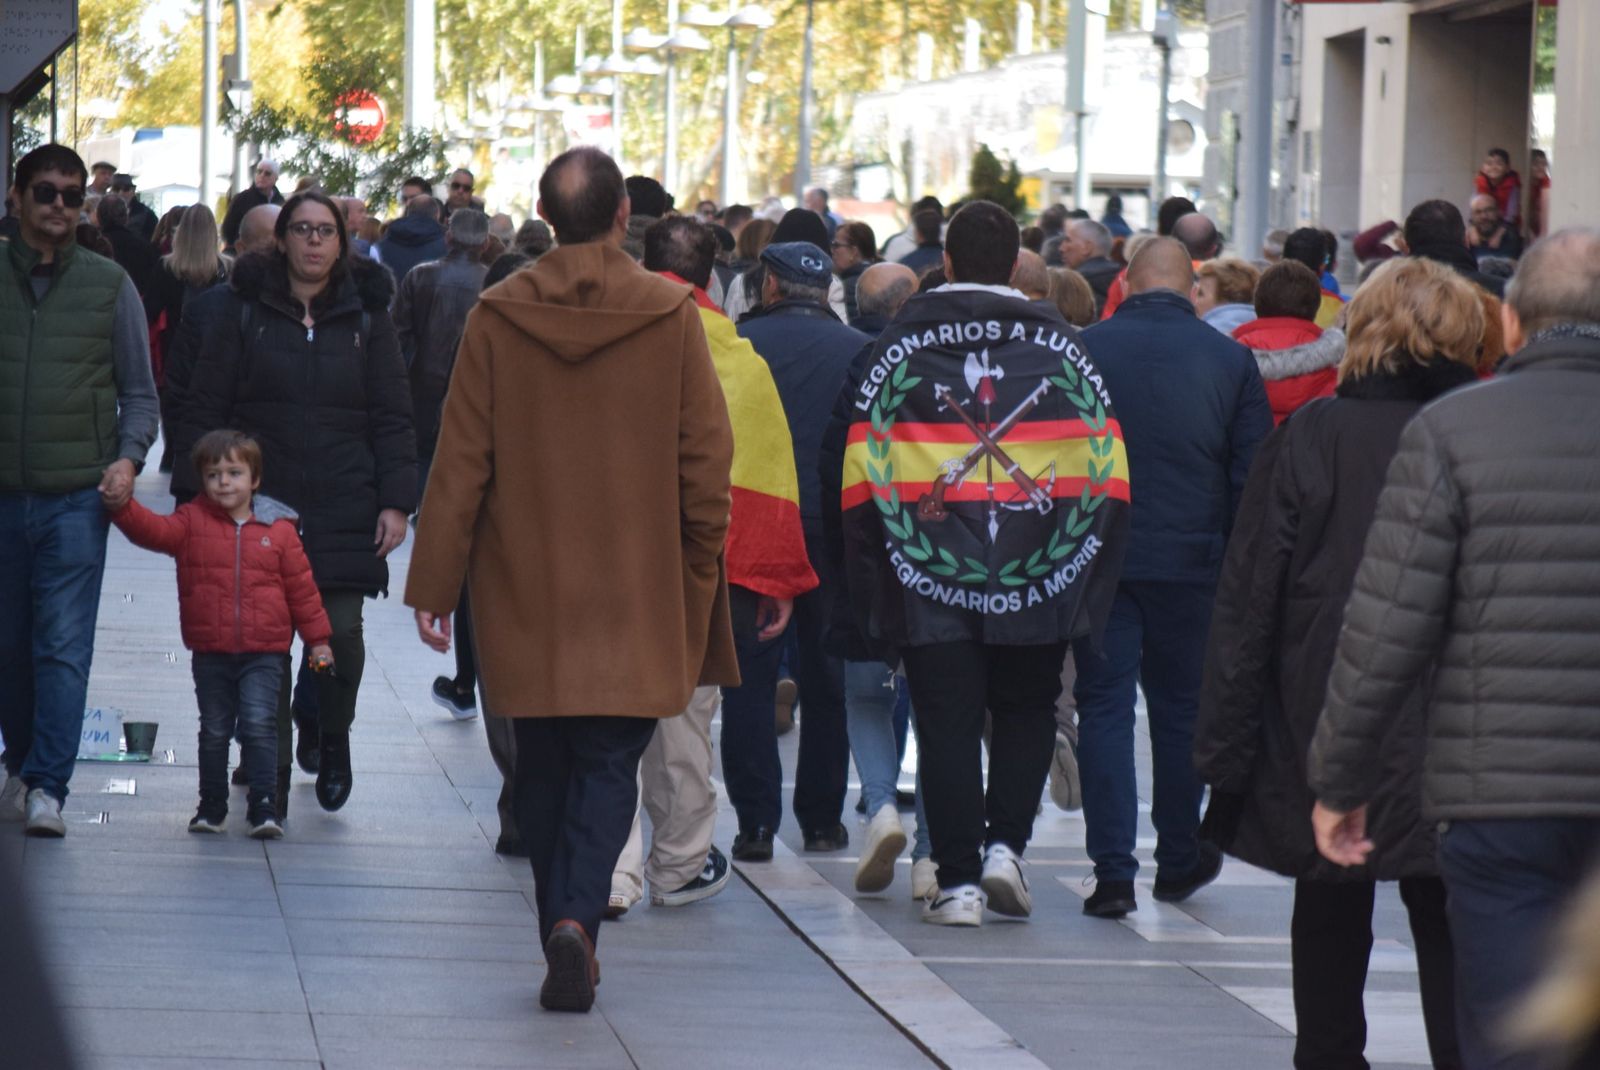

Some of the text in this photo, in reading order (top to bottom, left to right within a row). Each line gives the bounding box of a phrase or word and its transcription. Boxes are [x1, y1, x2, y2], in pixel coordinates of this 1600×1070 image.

[855, 320, 1112, 412] LEGIONARIOS A LUCHAR
[885, 534, 1103, 614] EGIONARIOS A MORIR
